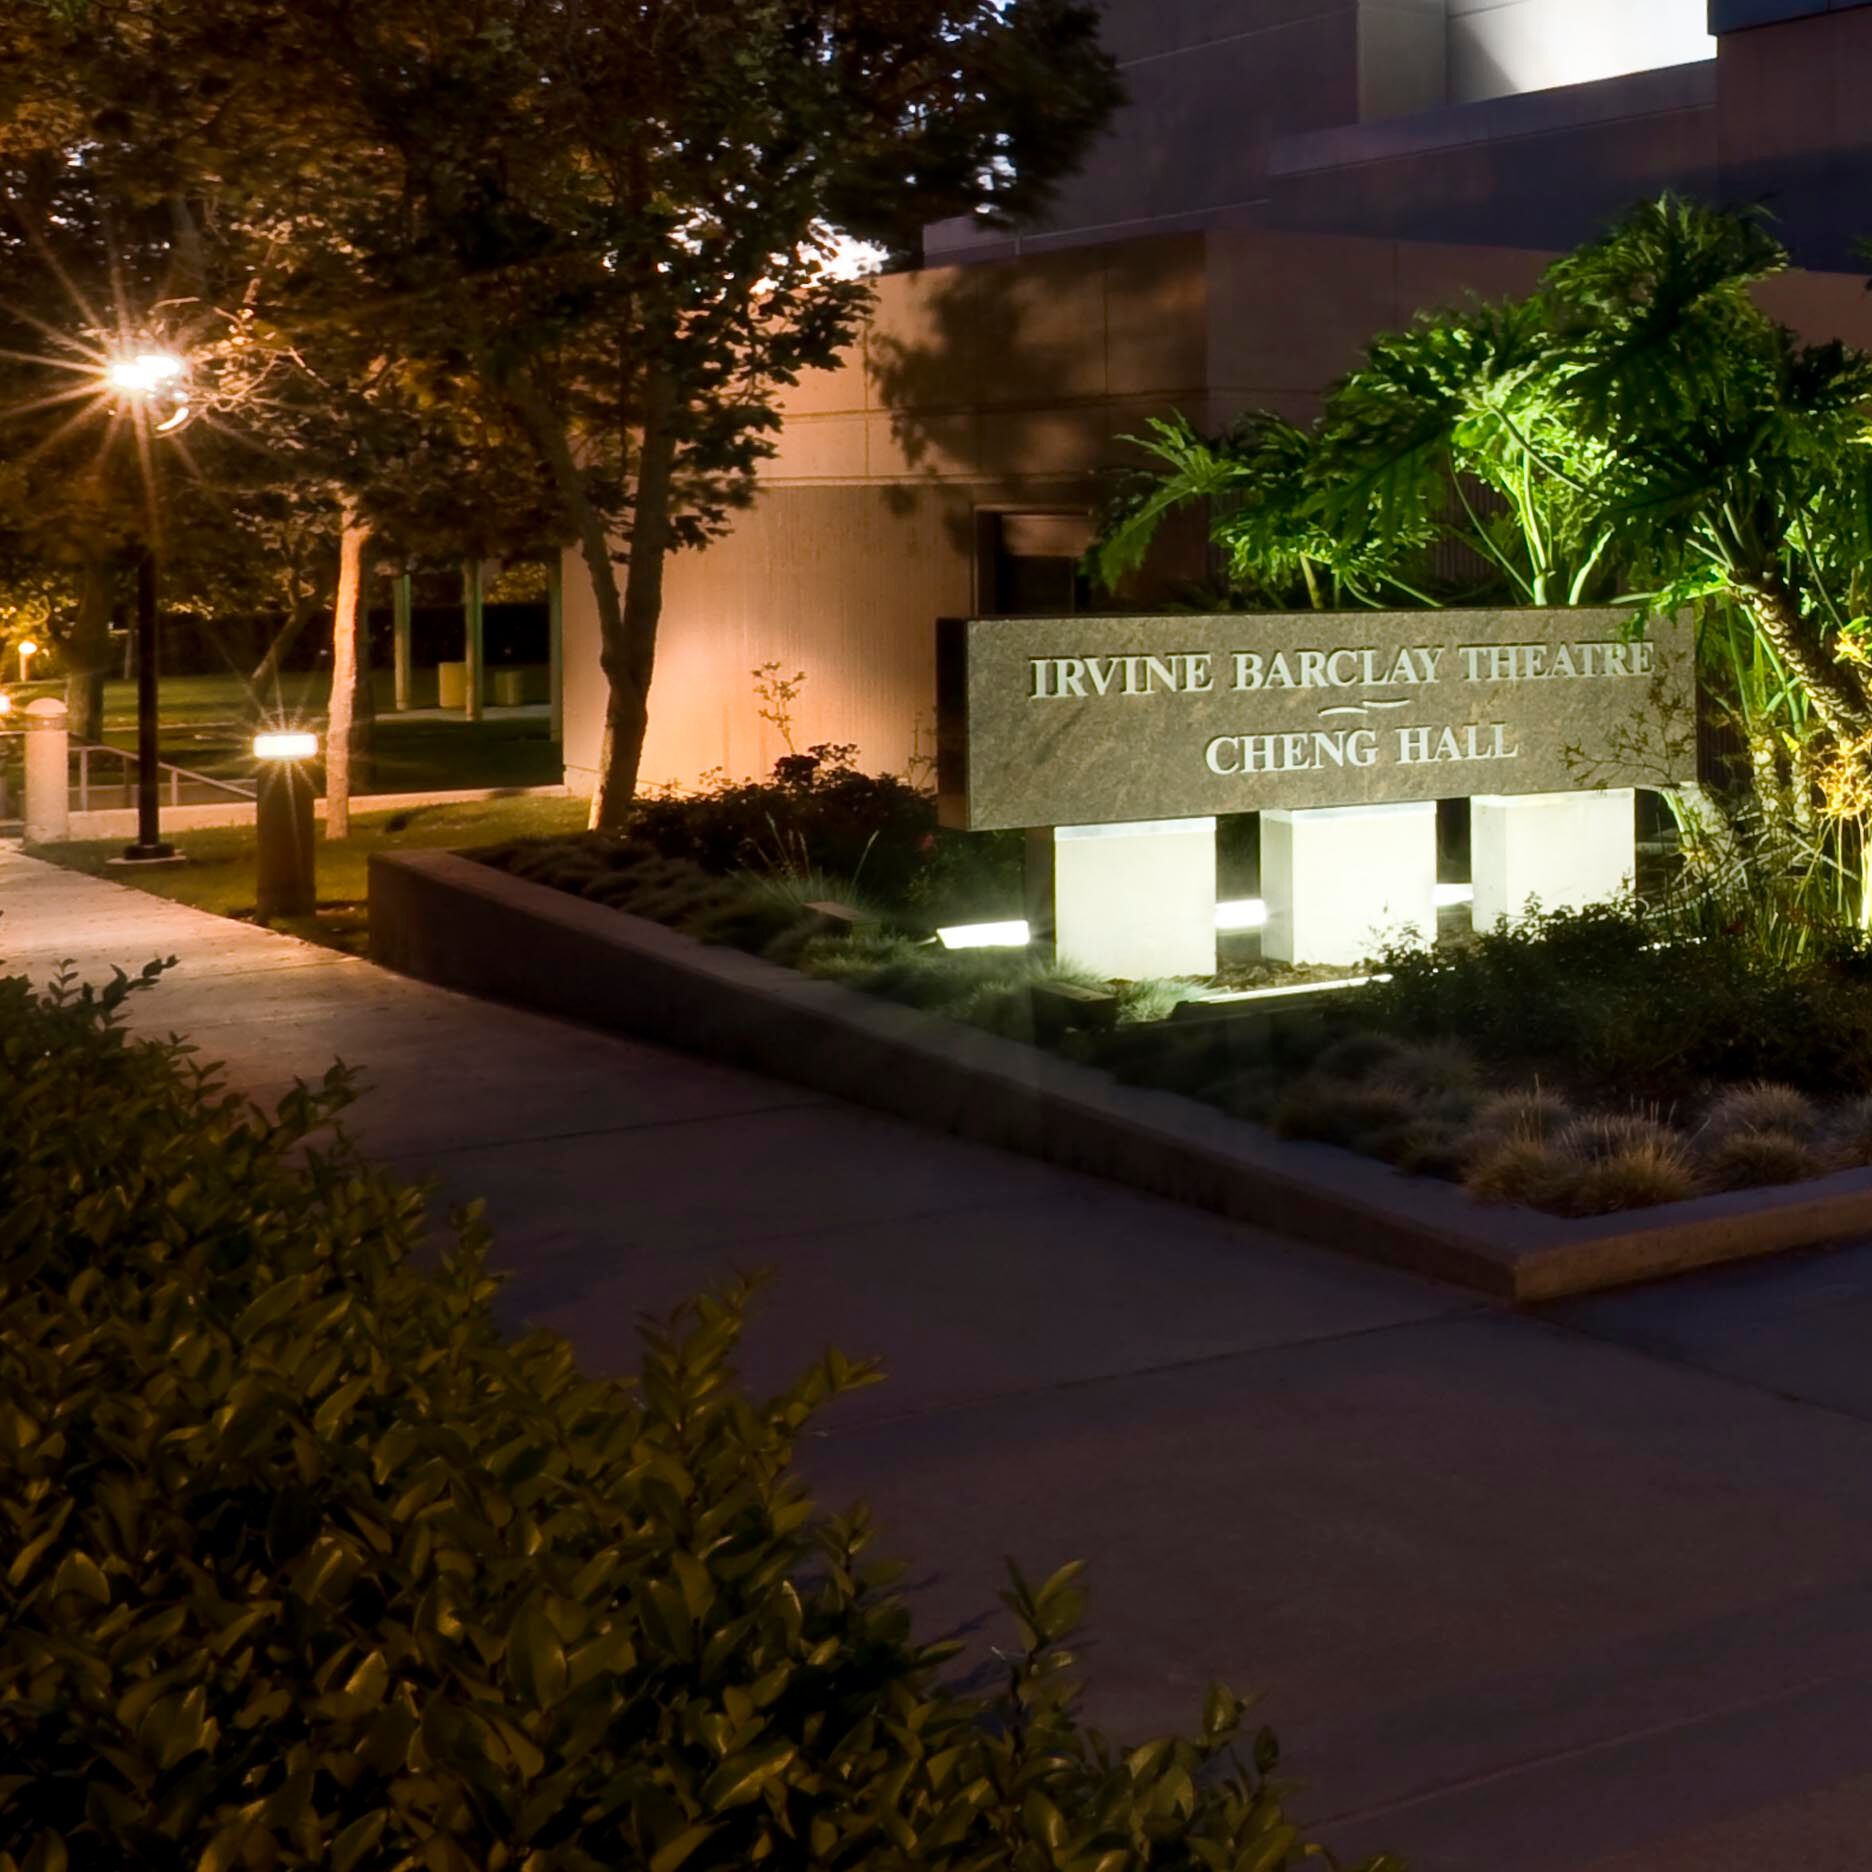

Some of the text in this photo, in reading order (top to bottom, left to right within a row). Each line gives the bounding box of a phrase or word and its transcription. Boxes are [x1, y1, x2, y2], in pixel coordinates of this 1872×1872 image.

[1028, 640, 1656, 699] IRVINE BARCLAY THEATRE
[1205, 723, 1519, 775] CHENG HALL
